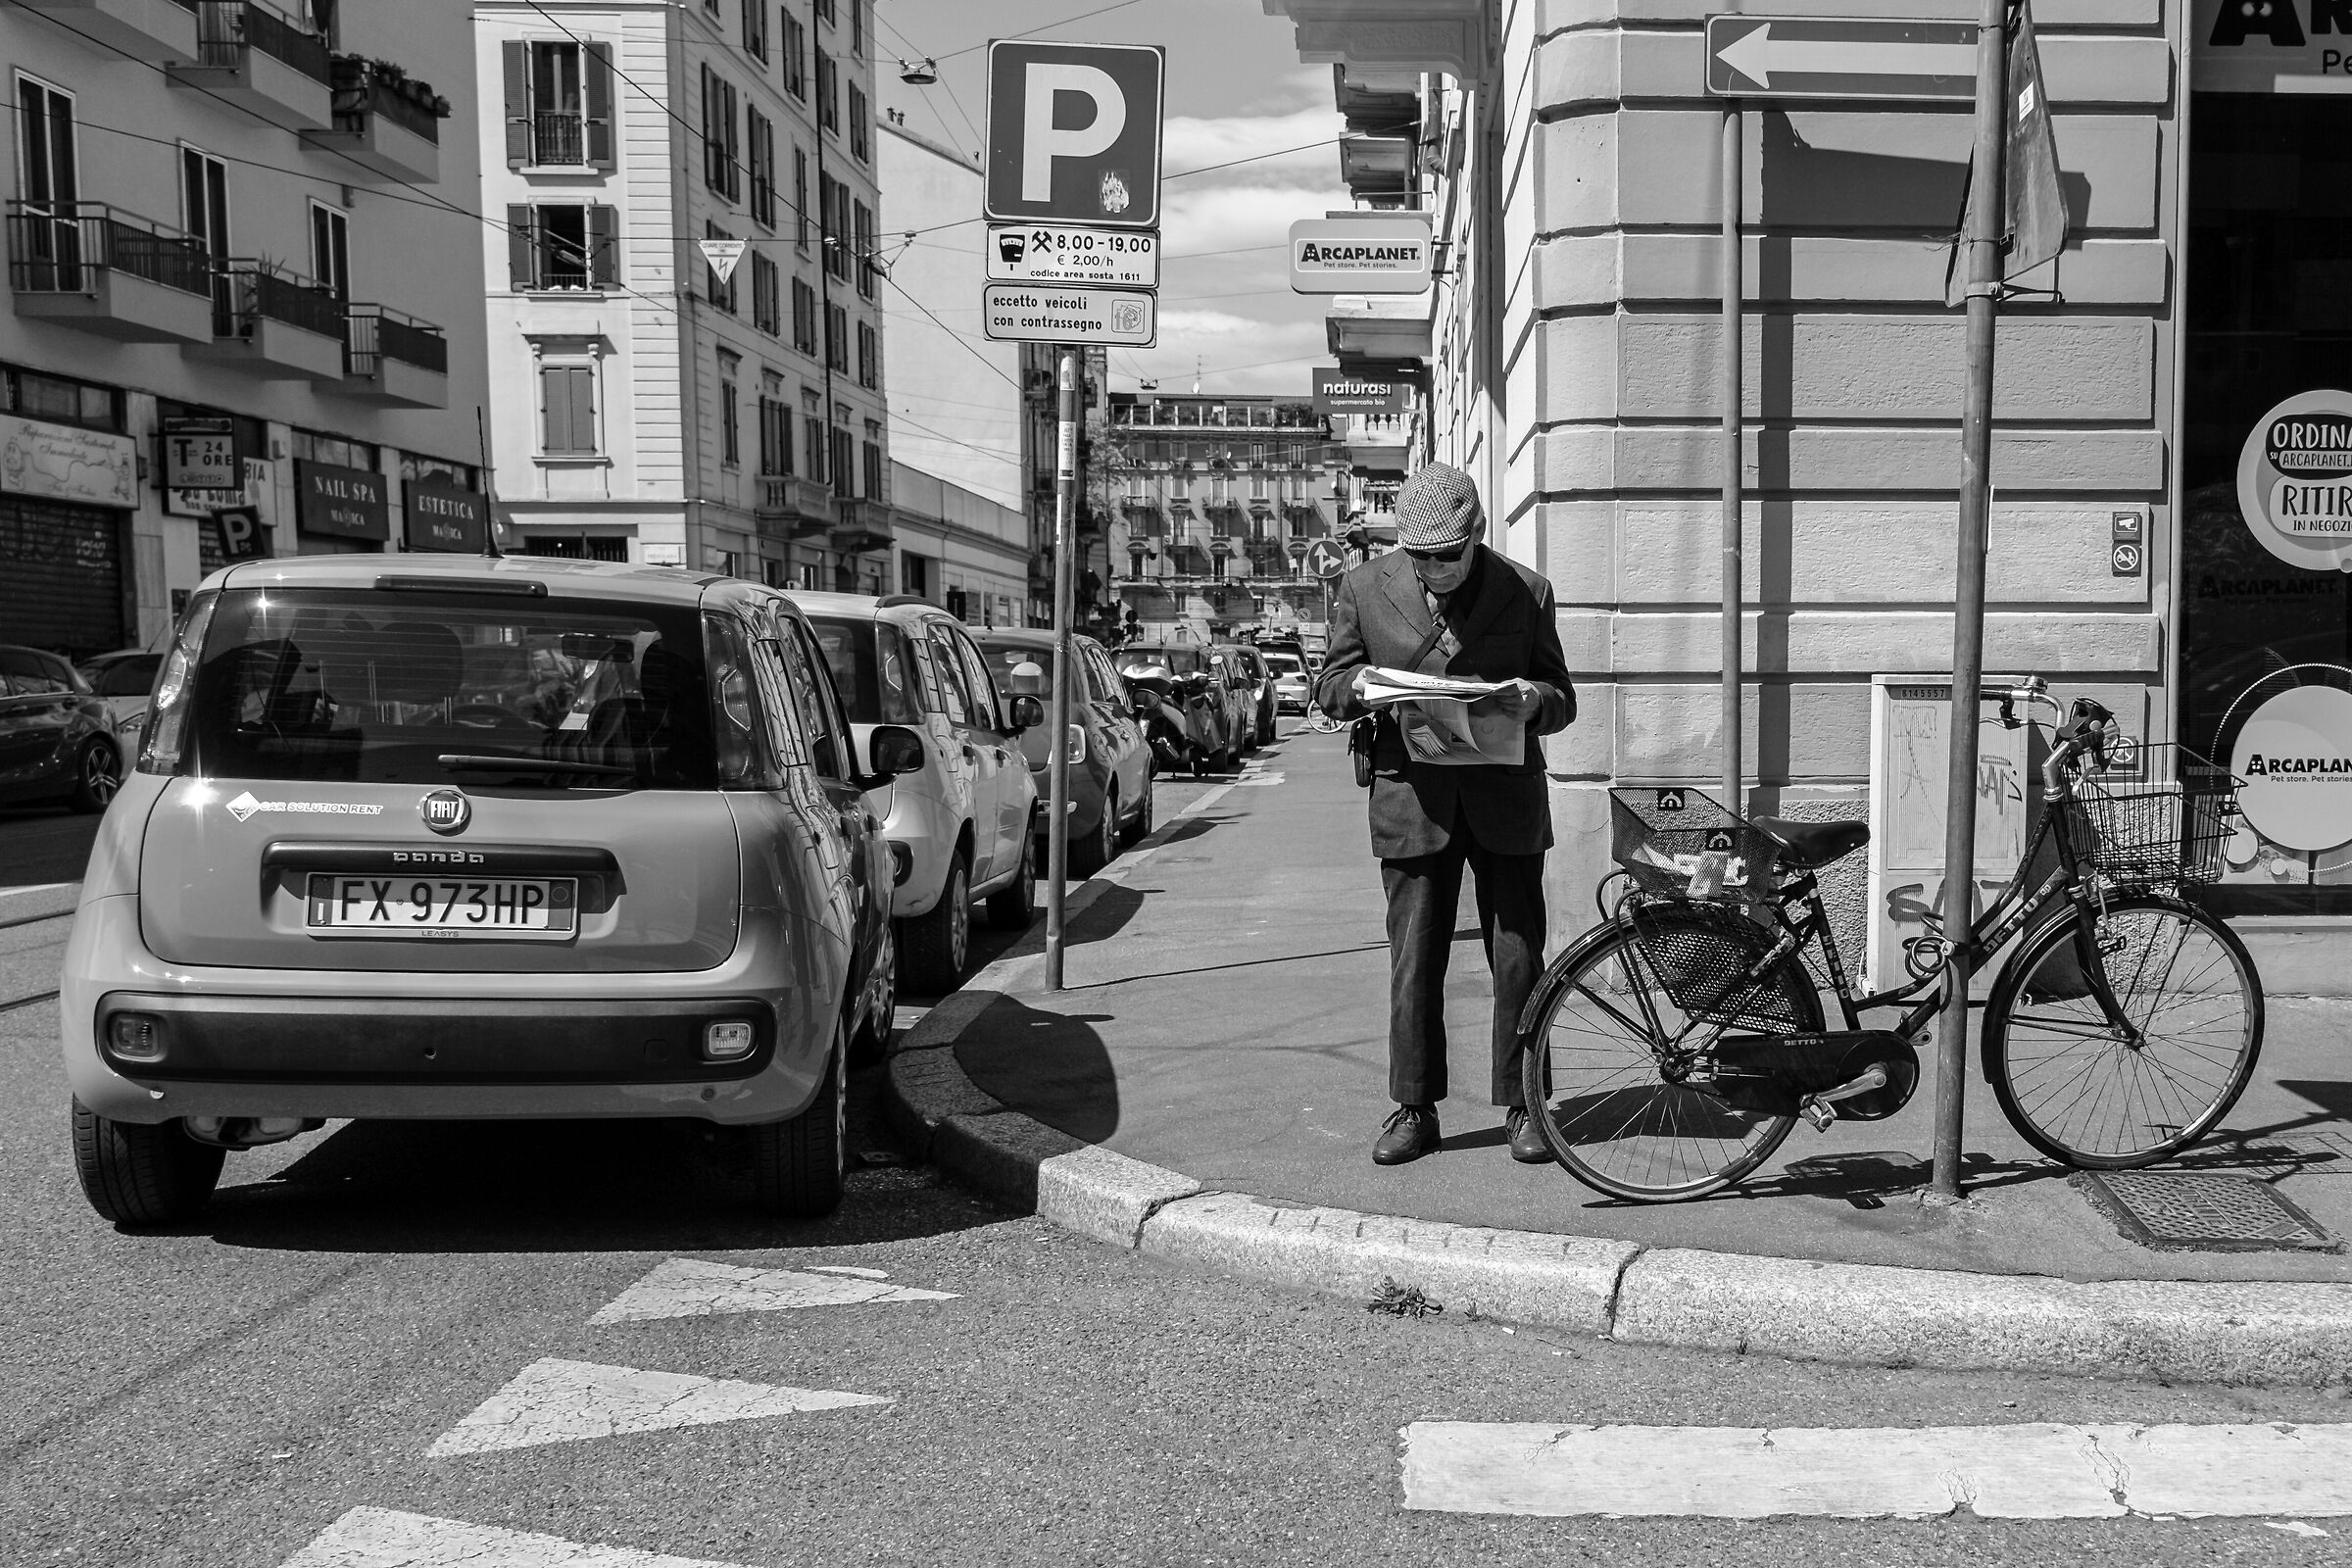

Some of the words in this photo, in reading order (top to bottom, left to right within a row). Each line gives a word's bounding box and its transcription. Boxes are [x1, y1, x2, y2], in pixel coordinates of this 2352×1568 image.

[1022, 63, 1126, 202] P
[1301, 243, 1418, 262] ARCAPLANET
[1073, 255, 1113, 267] 2,00/h
[993, 295, 1038, 308] eccetto
[1045, 296, 1087, 310] veicoli
[994, 317, 1013, 326] con
[1021, 316, 1102, 332] contrassegno
[205, 442, 223, 453] 24
[203, 455, 233, 466] ORE
[315, 476, 348, 499] NAIL
[353, 482, 376, 503] SPA
[418, 495, 474, 520] ESTETICA
[2293, 519, 2306, 531] IN
[2309, 519, 2352, 532] NEGOZI
[221, 514, 252, 554] P
[1901, 689, 1945, 698] 8145557
[260, 801, 286, 811] CAR
[287, 802, 348, 813] SOLUTION
[349, 805, 384, 815] RENT
[430, 800, 458, 818] FIAT
[393, 851, 484, 863] panda
[341, 880, 392, 921] FX
[410, 882, 544, 924] 973HP
